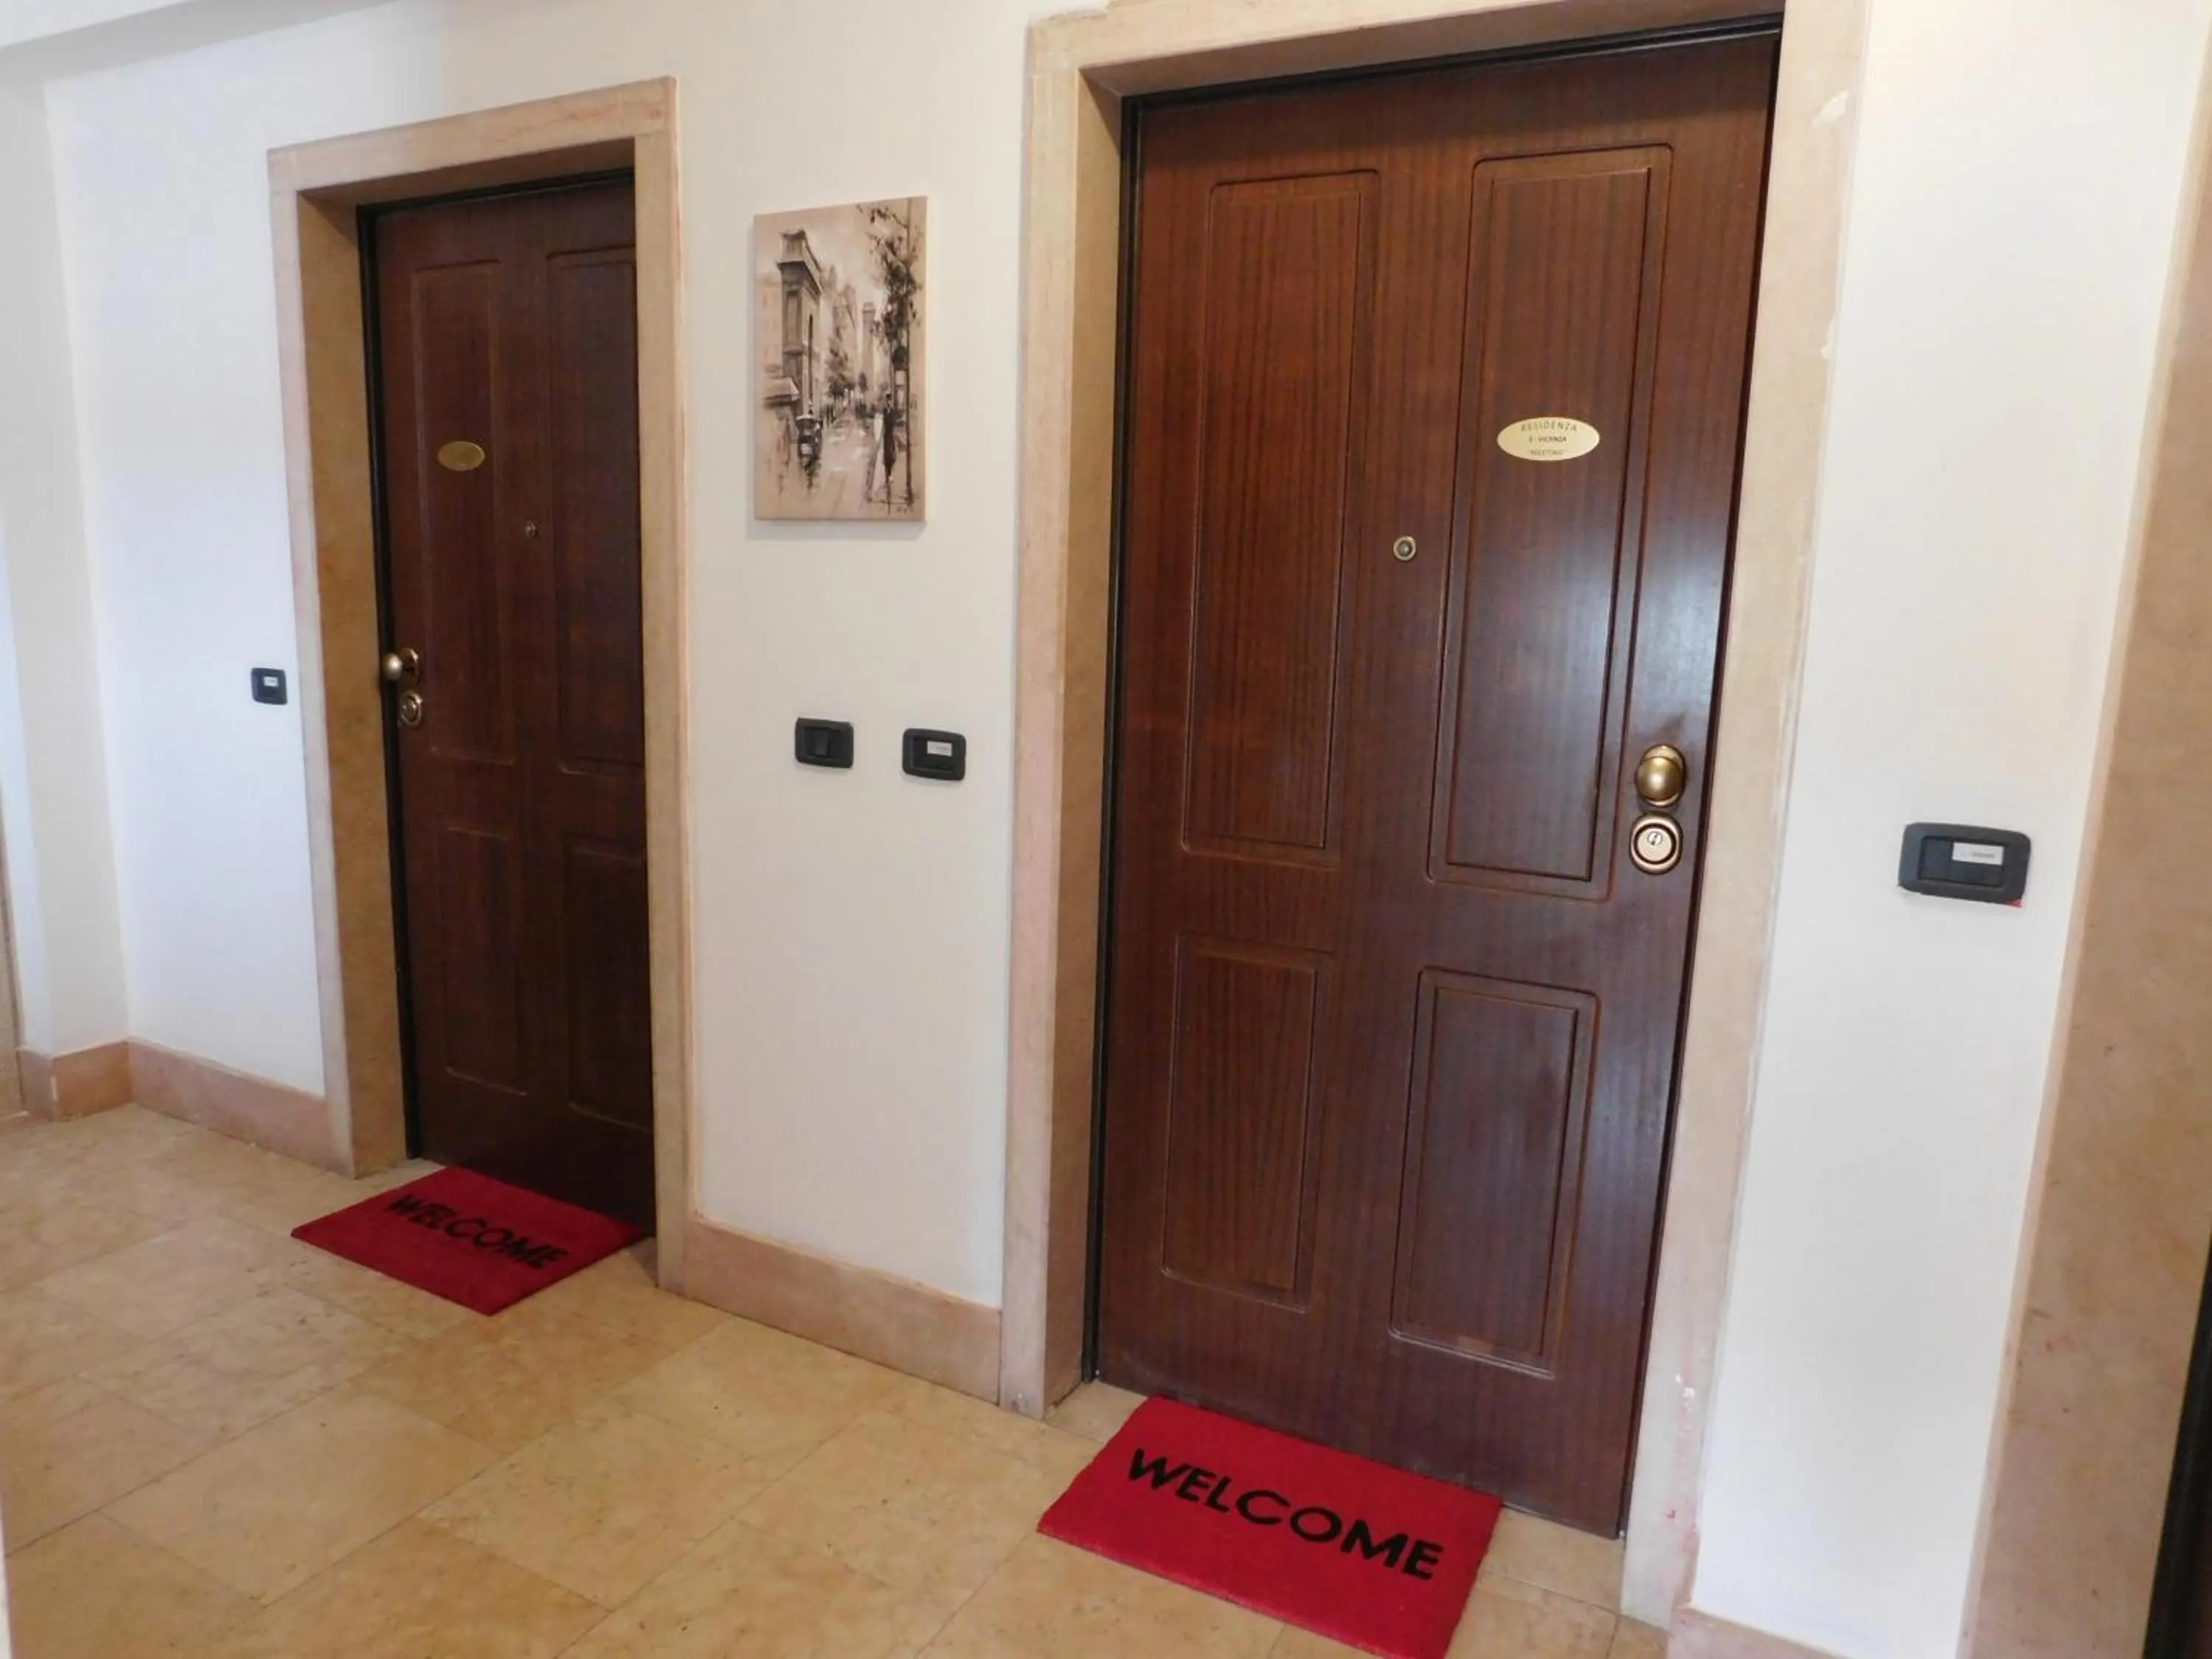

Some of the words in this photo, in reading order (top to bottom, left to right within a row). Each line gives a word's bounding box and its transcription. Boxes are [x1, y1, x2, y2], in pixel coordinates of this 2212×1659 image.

[1521, 421, 1578, 432] RESIDENZA
[386, 1196, 568, 1269] WELCOME
[1127, 1448, 1444, 1580] WELCOME
